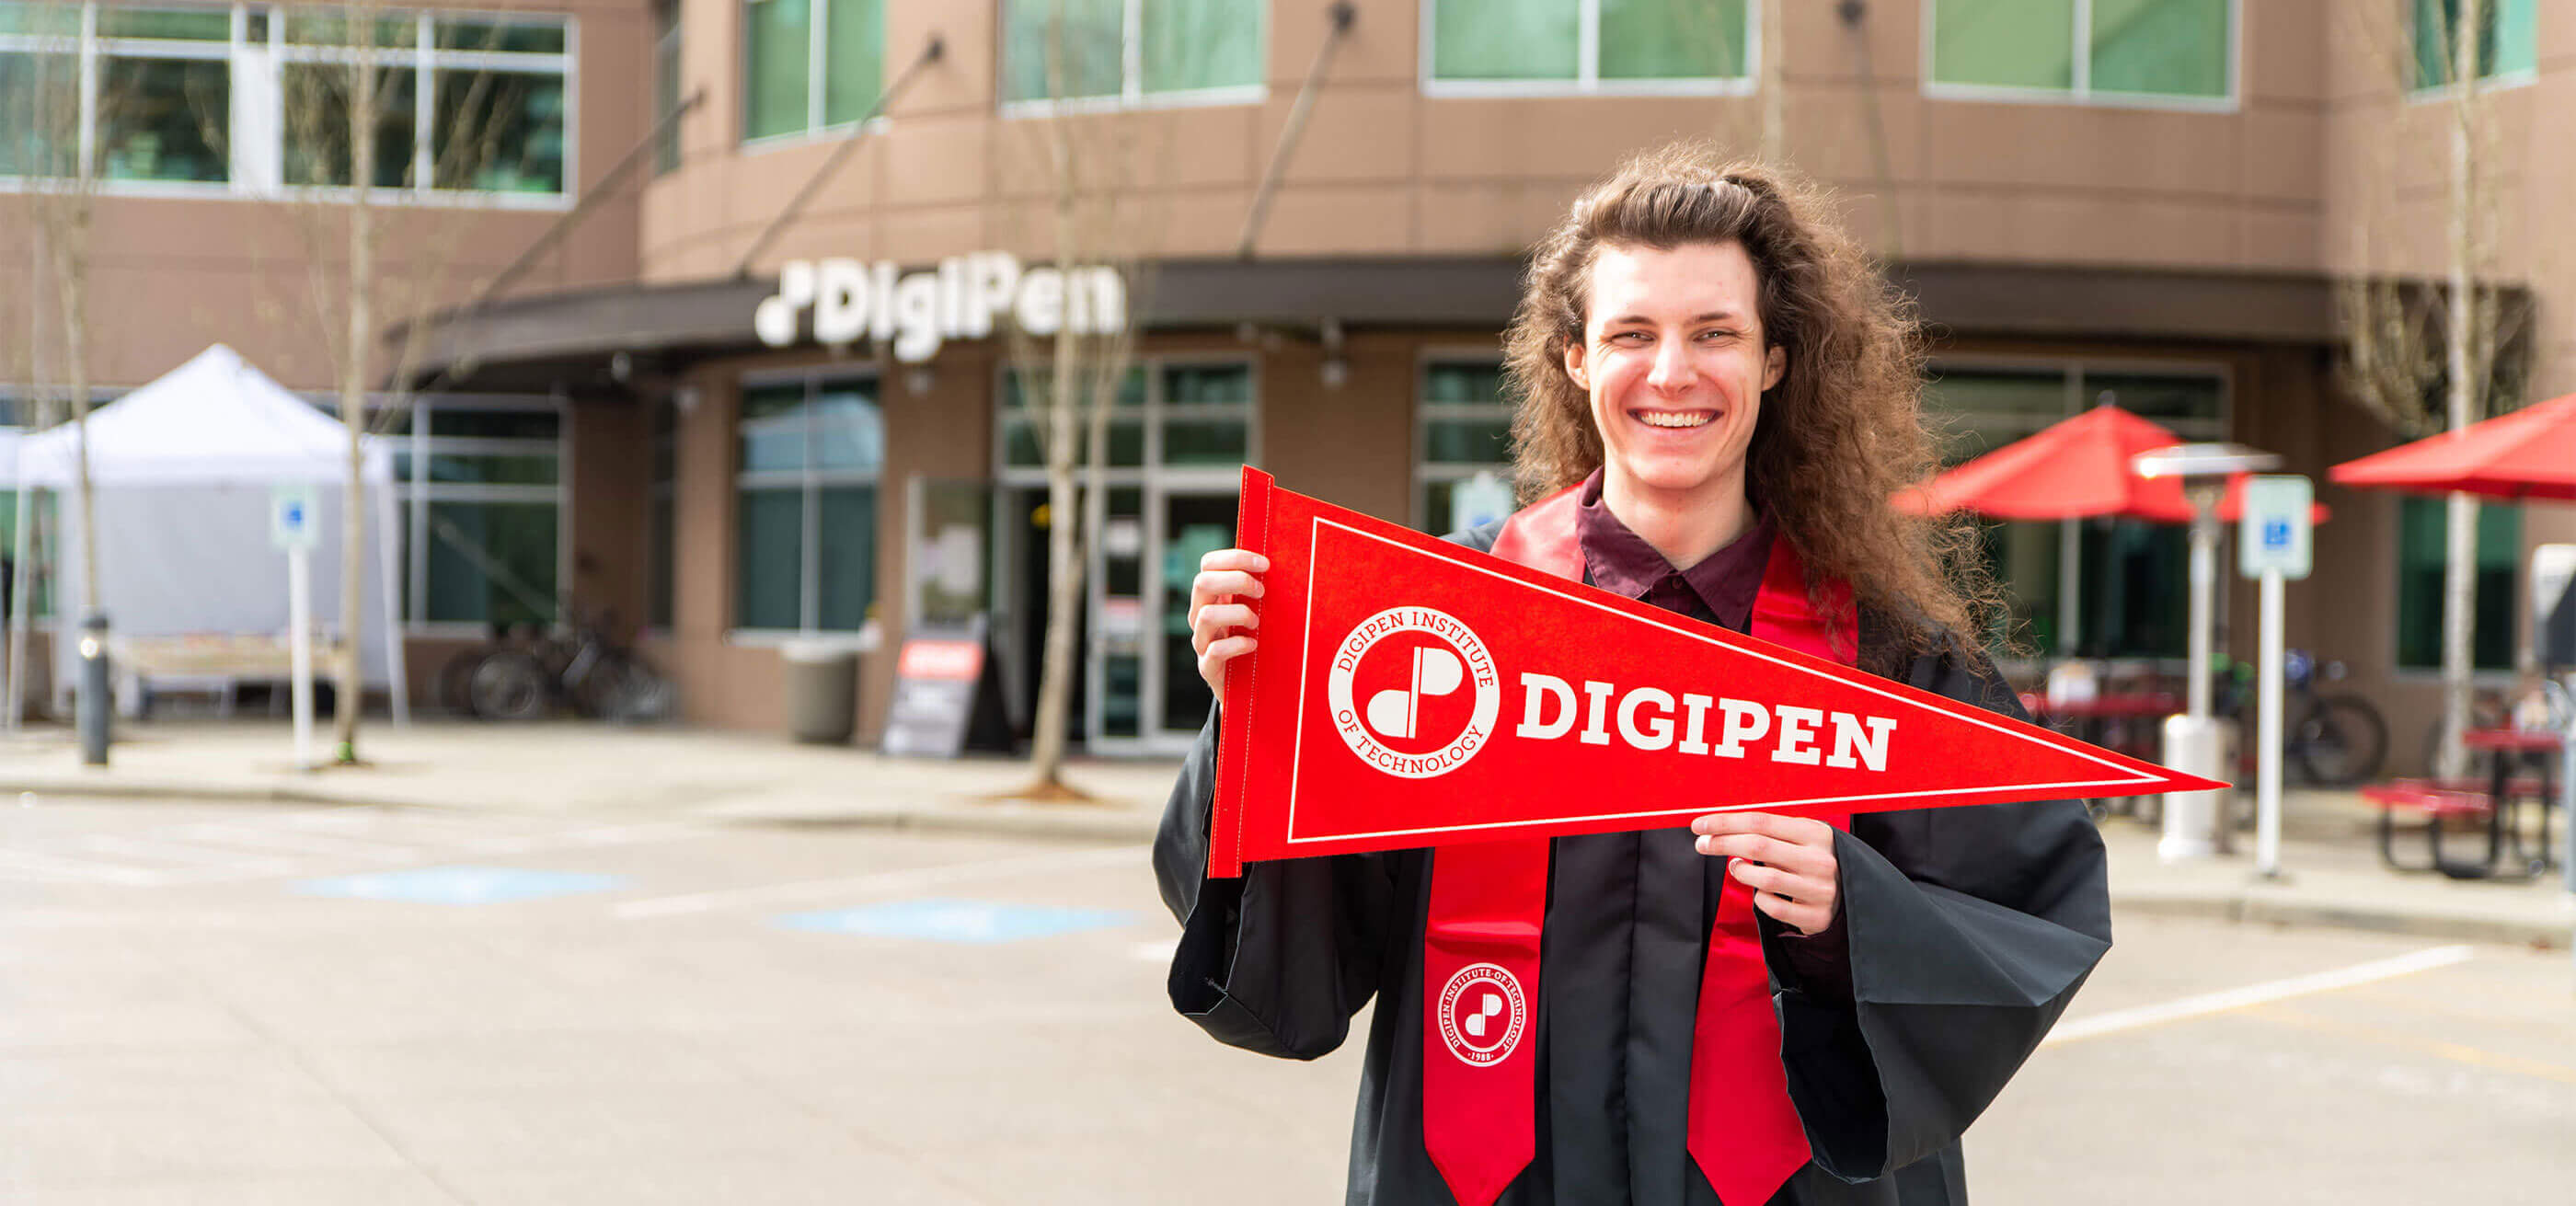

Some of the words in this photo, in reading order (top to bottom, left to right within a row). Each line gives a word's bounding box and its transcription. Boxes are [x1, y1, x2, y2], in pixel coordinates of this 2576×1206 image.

[812, 250, 1128, 362] DigiPen
[1338, 612, 1405, 672] DIGIPEN
[1412, 611, 1494, 688] INSTITUTE
[1338, 709, 1360, 734] OF
[1355, 725, 1484, 774] TECHNOLOGY
[1515, 672, 1898, 772] DIGIPEN
